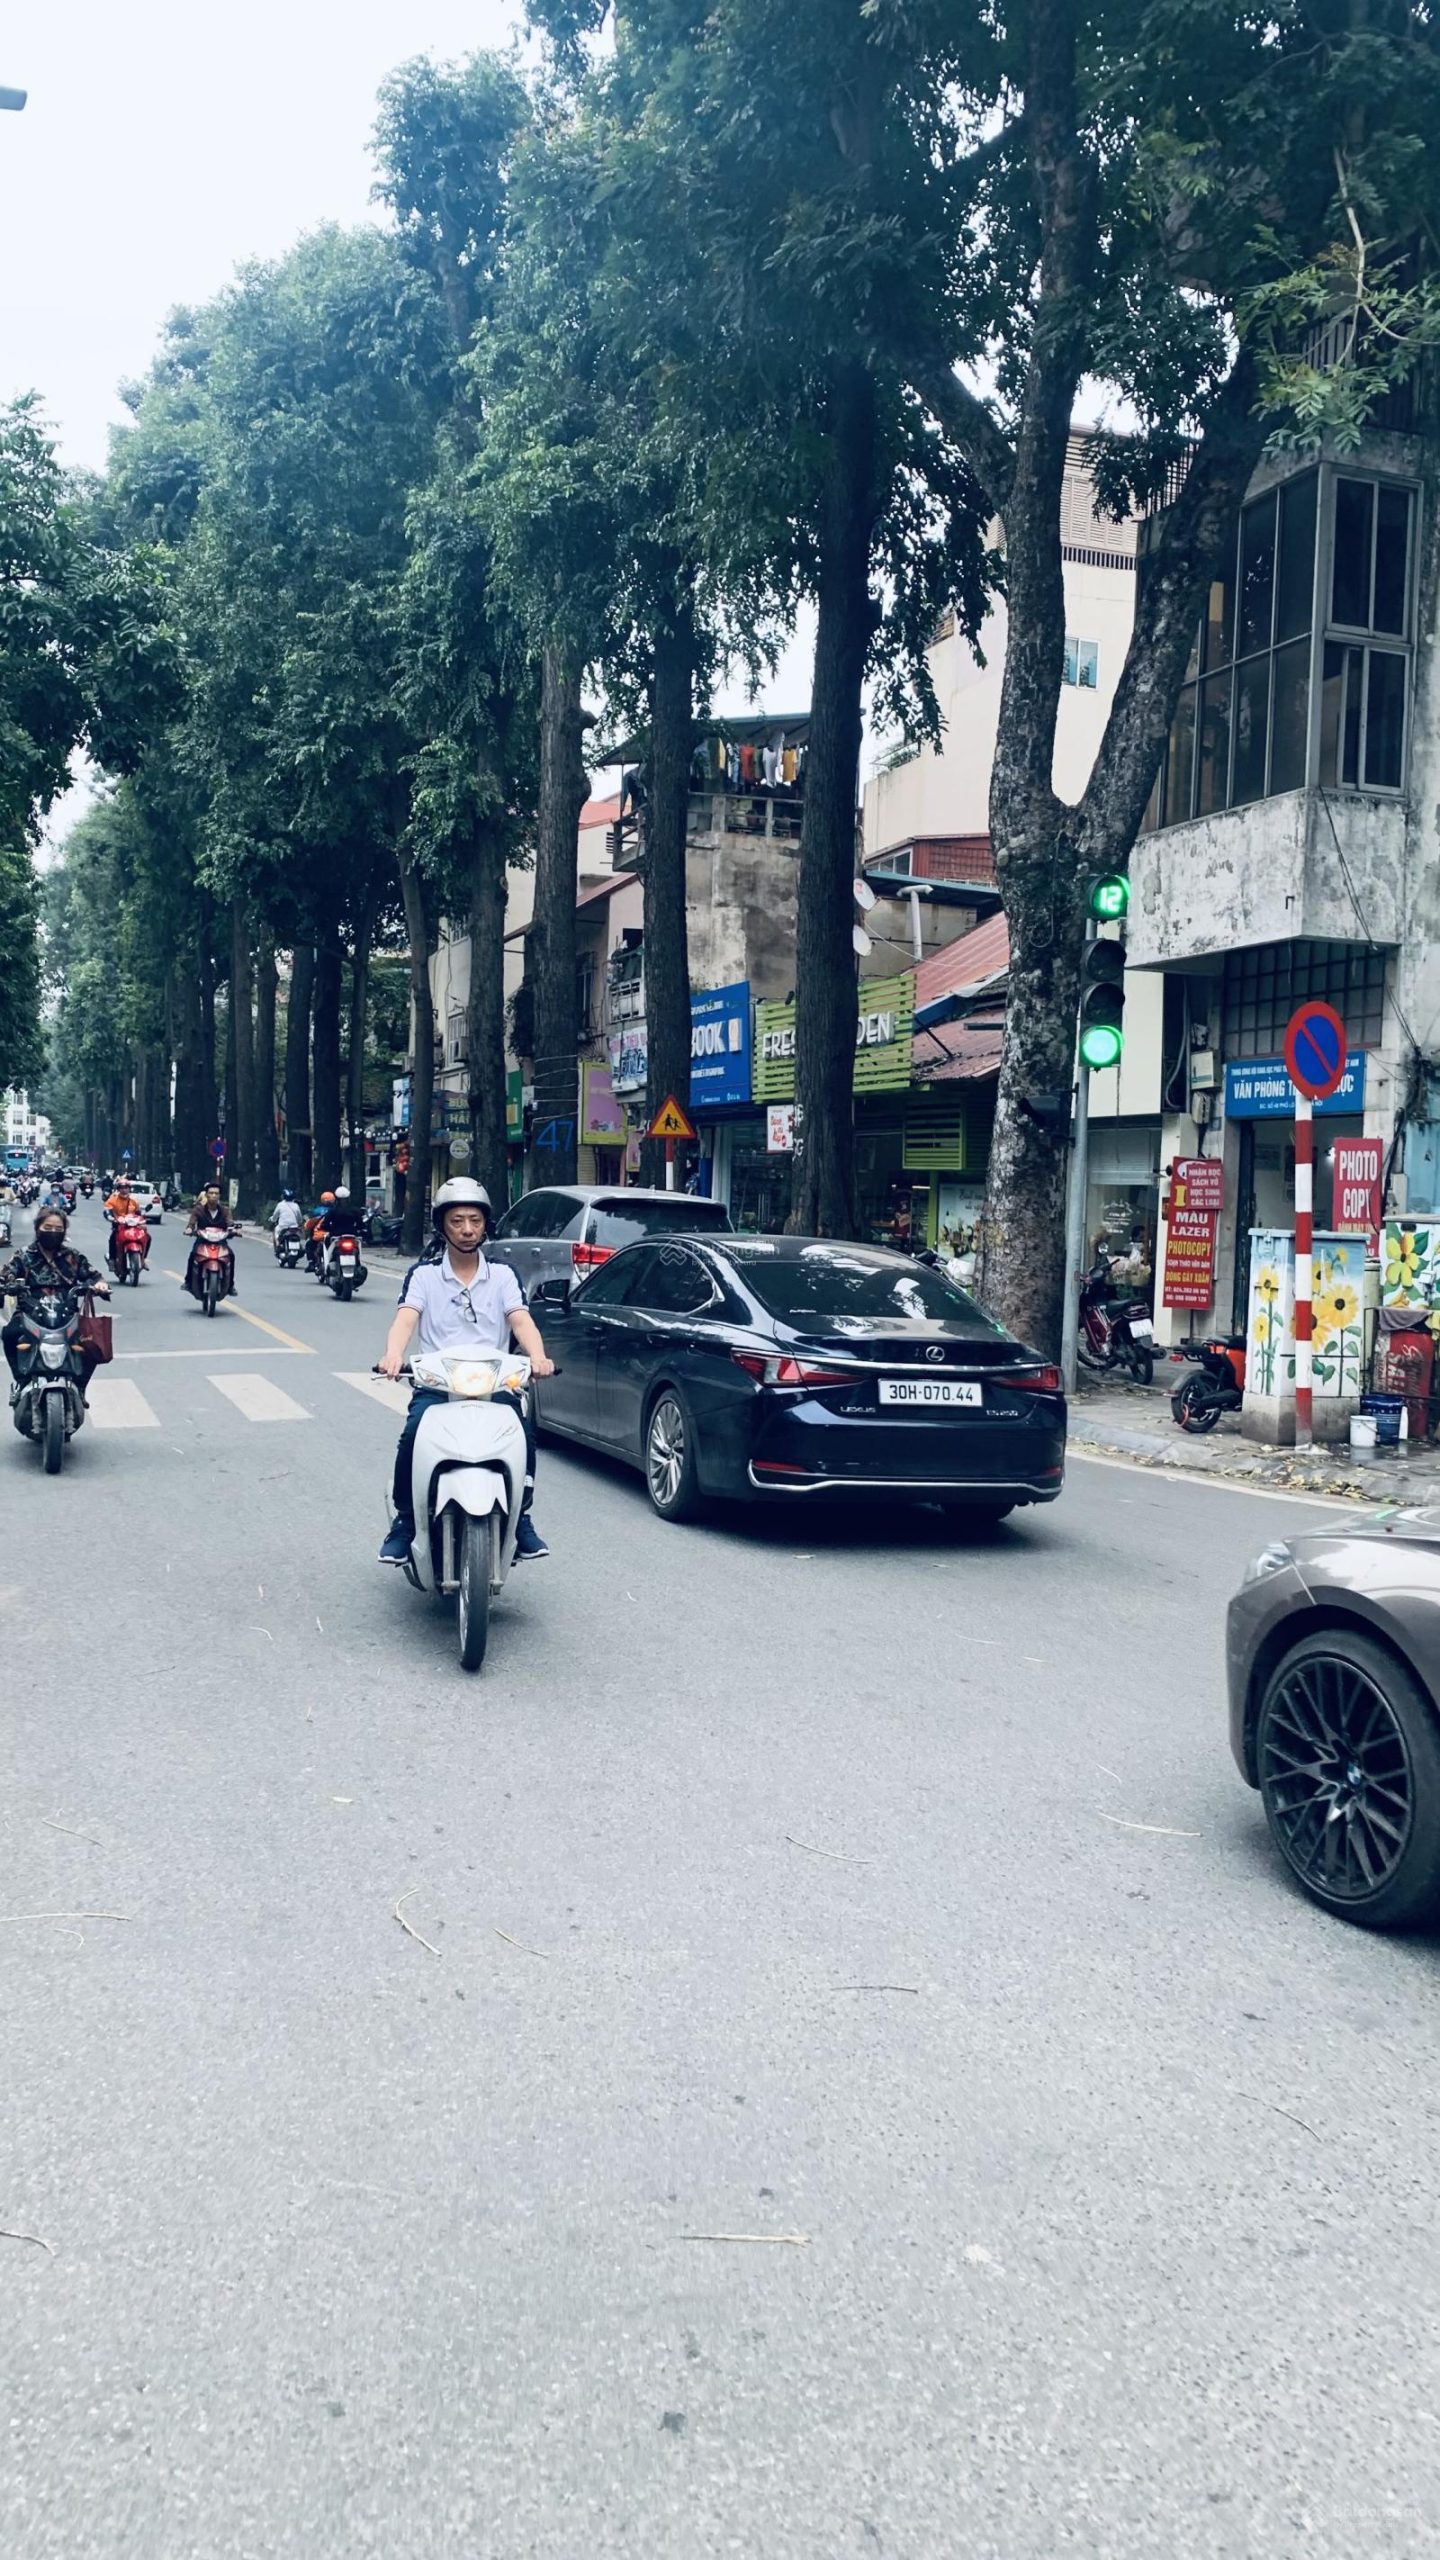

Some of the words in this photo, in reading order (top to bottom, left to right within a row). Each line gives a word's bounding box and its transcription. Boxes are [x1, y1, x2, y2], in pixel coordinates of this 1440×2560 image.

[1100, 885, 1122, 912] 12
[762, 1028, 796, 1058] FRES
[856, 1012, 894, 1046] DEN
[1234, 1079, 1252, 1099] VĂN
[1254, 1077, 1286, 1099] PHÒNG
[535, 1119, 574, 1153] 47
[1339, 1150, 1378, 1181] PHOTO
[1192, 1177, 1209, 1186] SÁCH
[1343, 1187, 1372, 1218] COPY
[1175, 1210, 1209, 1224] MÀU
[1171, 1225, 1210, 1238] LAZER
[1167, 1240, 1211, 1257] PHOTOCOPY
[889, 1384, 974, 1402] 30H-070.44
[839, 1405, 876, 1413] LEXUS
